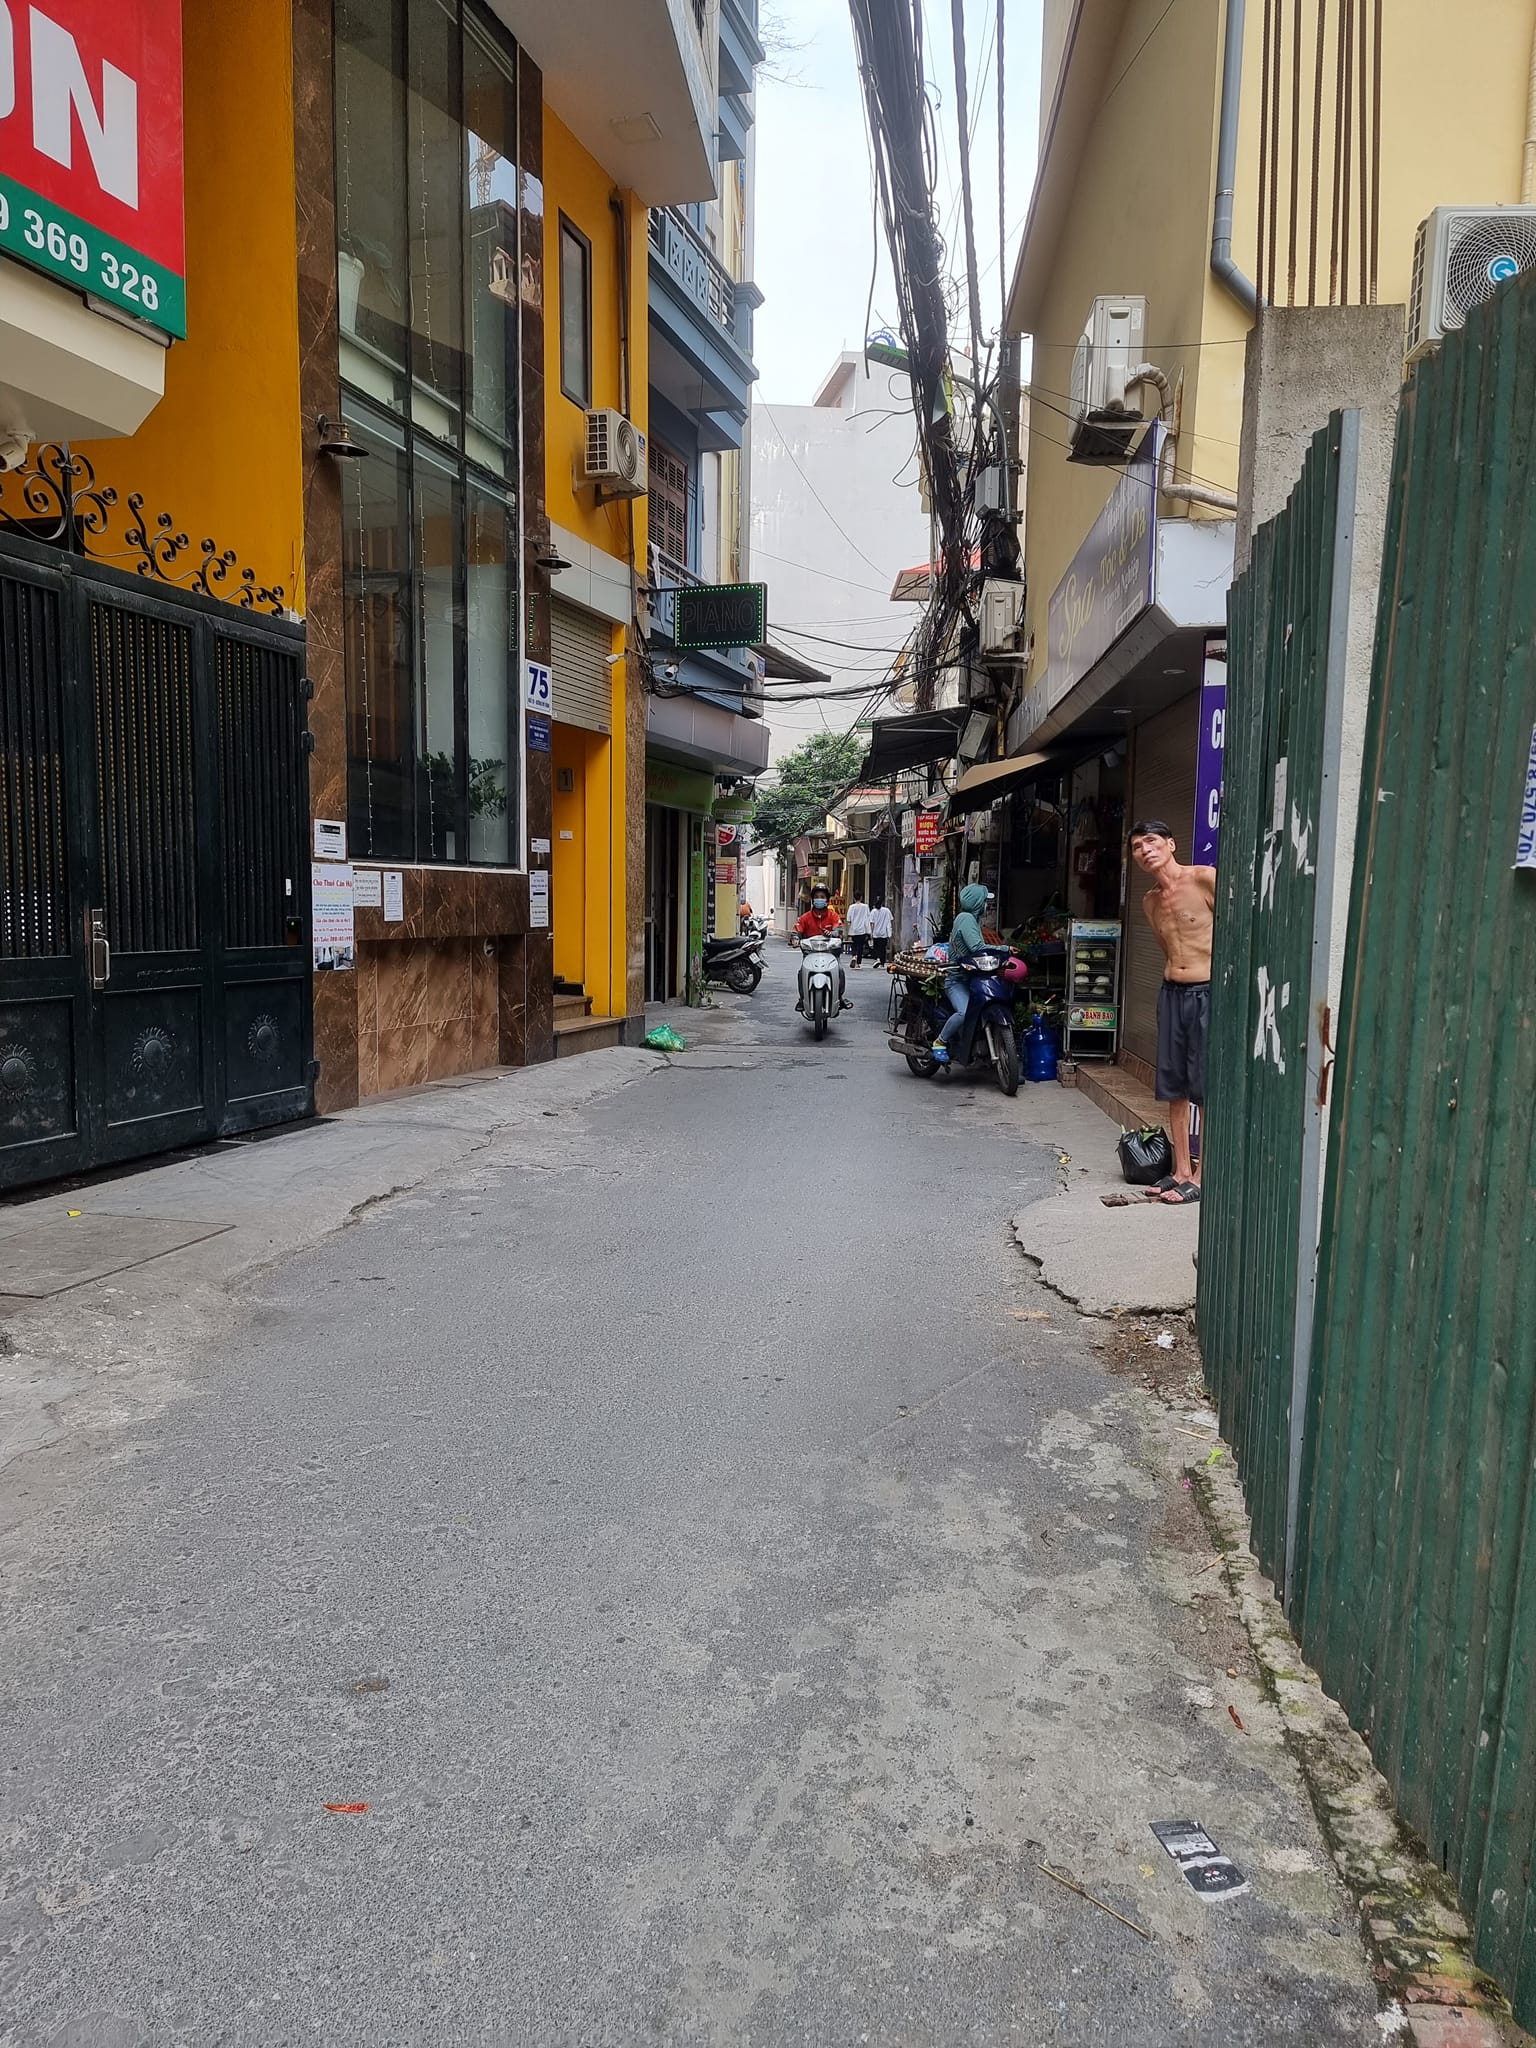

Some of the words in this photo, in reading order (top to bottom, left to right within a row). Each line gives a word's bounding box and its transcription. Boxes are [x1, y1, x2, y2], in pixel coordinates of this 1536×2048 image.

[24, 208, 89, 273] 369
[101, 252, 159, 311] 328
[681, 599, 757, 633] PIANO
[1059, 573, 1097, 673] Spa
[529, 666, 549, 699] 75
